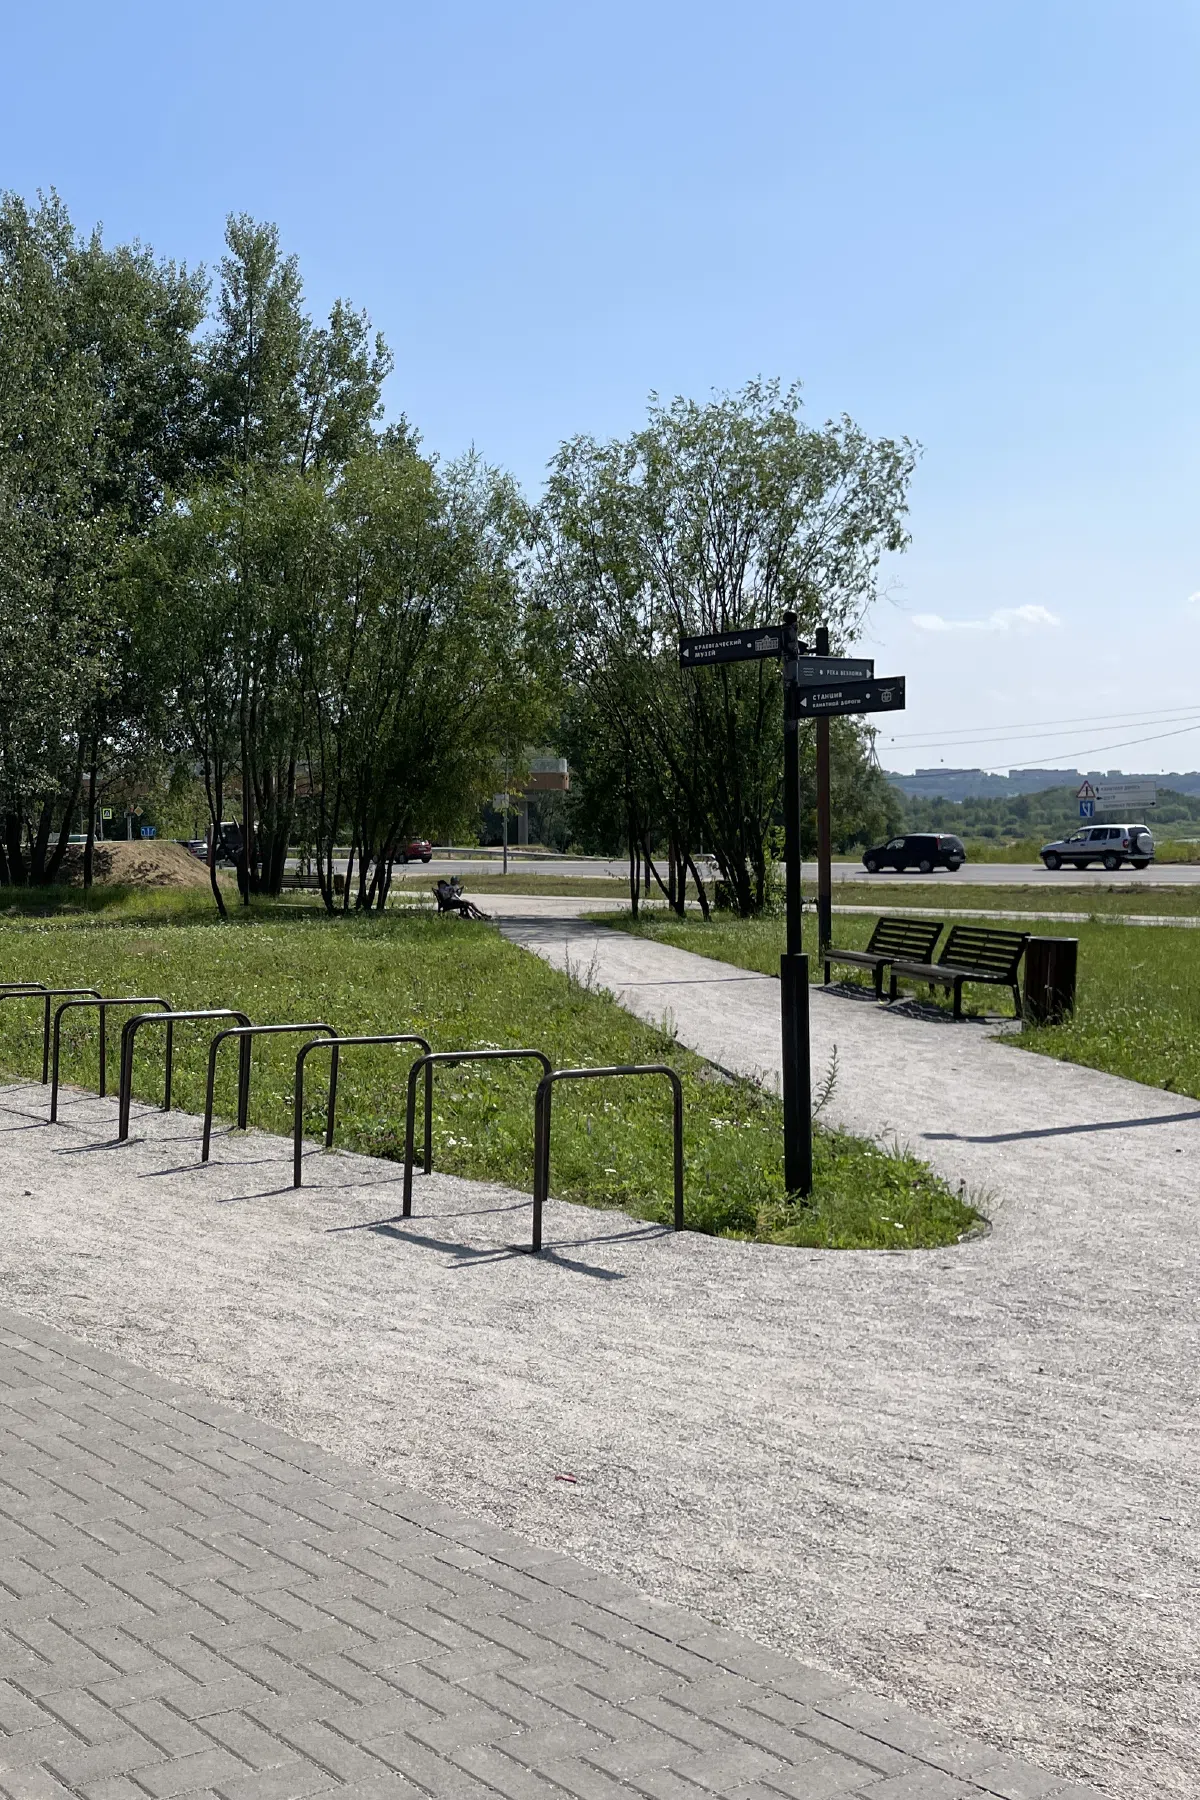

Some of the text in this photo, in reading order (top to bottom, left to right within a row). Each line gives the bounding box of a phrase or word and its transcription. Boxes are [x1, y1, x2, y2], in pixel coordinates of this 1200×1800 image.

[694, 638, 742, 651] КРАЕВЕДЧЕСКИЙ
[694, 649, 716, 658] МУЗЕЙ
[812, 692, 843, 701] СТАНЦИЯ
